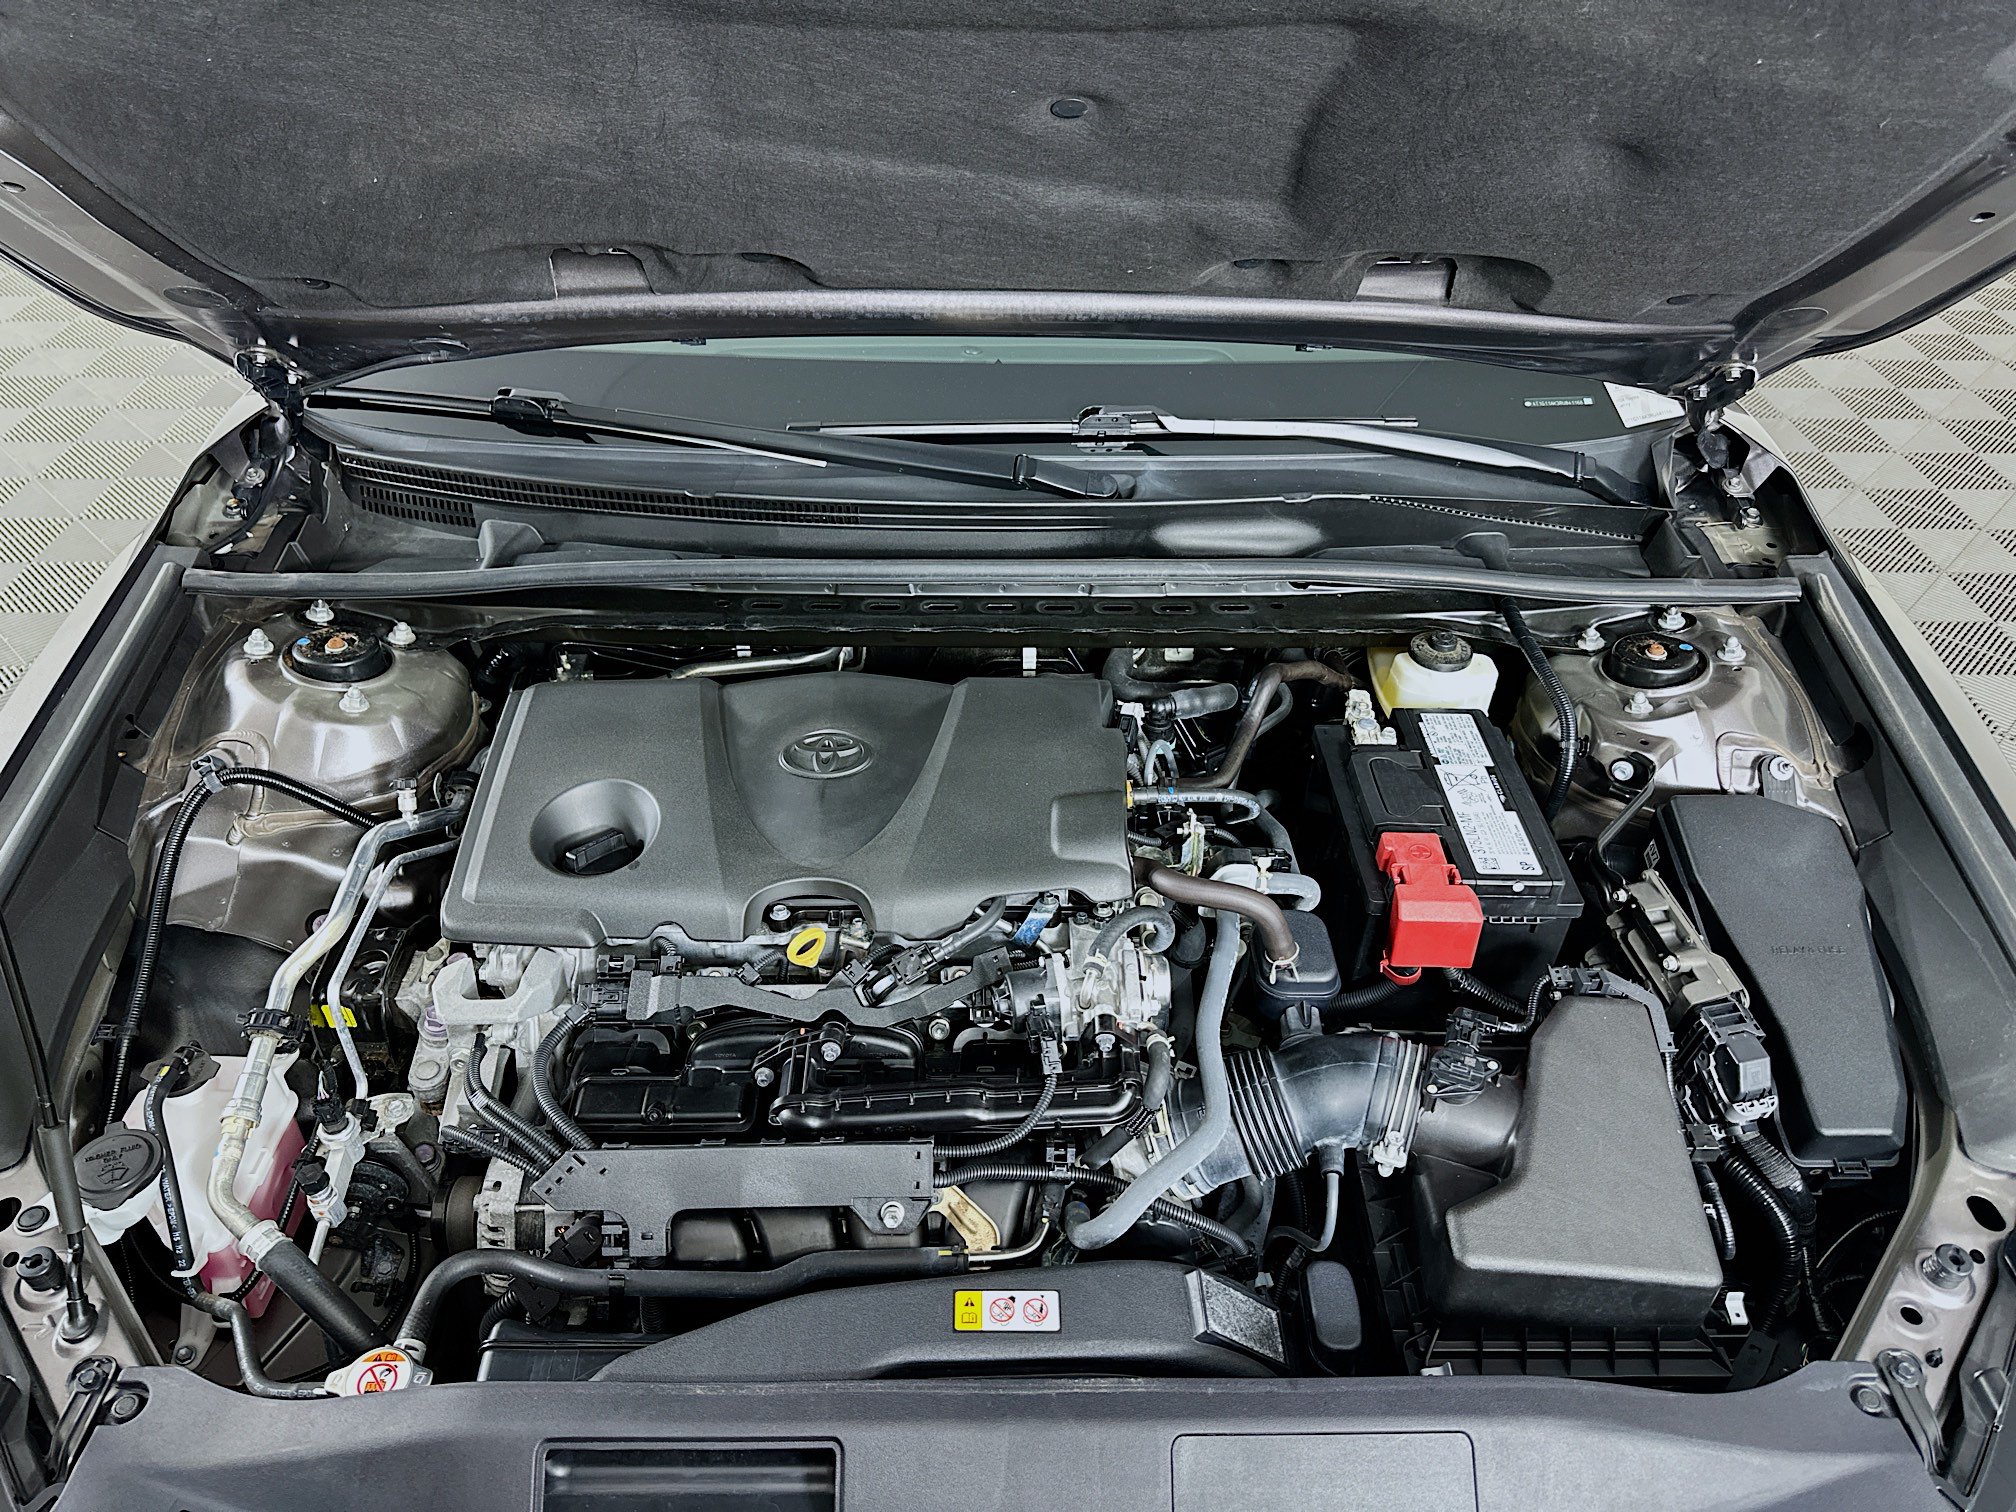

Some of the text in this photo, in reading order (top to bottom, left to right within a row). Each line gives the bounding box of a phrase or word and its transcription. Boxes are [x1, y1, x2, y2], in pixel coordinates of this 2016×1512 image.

[1771, 945, 1805, 955] RELAY
[1817, 945, 1847, 955] FUSE
[162, 1177, 172, 1203] WATER
